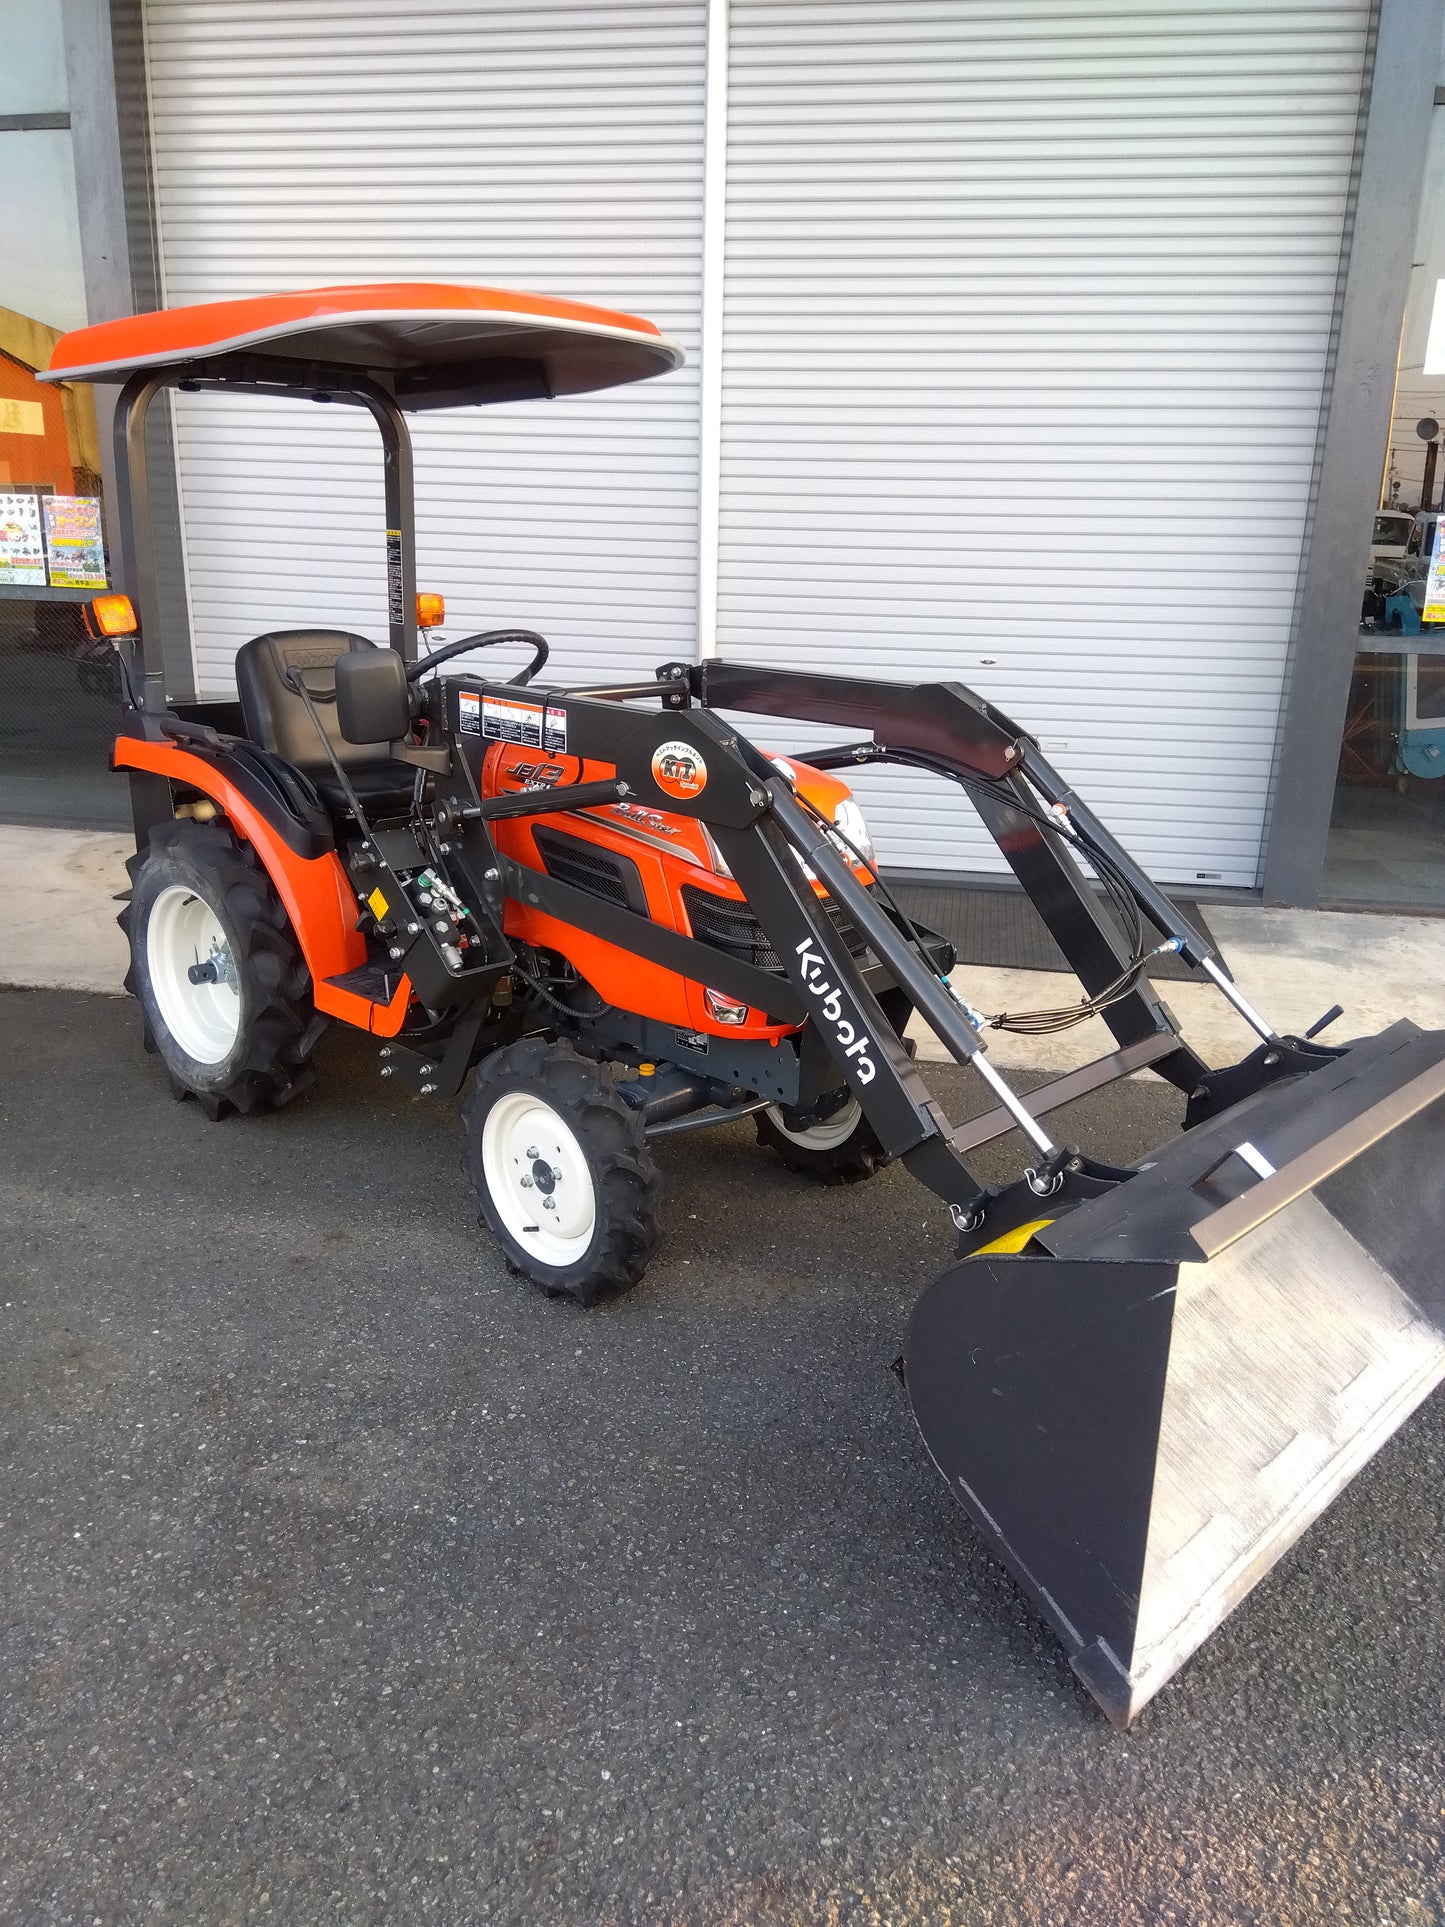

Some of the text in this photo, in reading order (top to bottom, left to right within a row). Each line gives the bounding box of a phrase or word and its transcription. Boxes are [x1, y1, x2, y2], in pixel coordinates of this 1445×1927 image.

[505, 761, 565, 783] JB13
[663, 759, 693, 780] KTI
[795, 937, 876, 1085] Kubota
